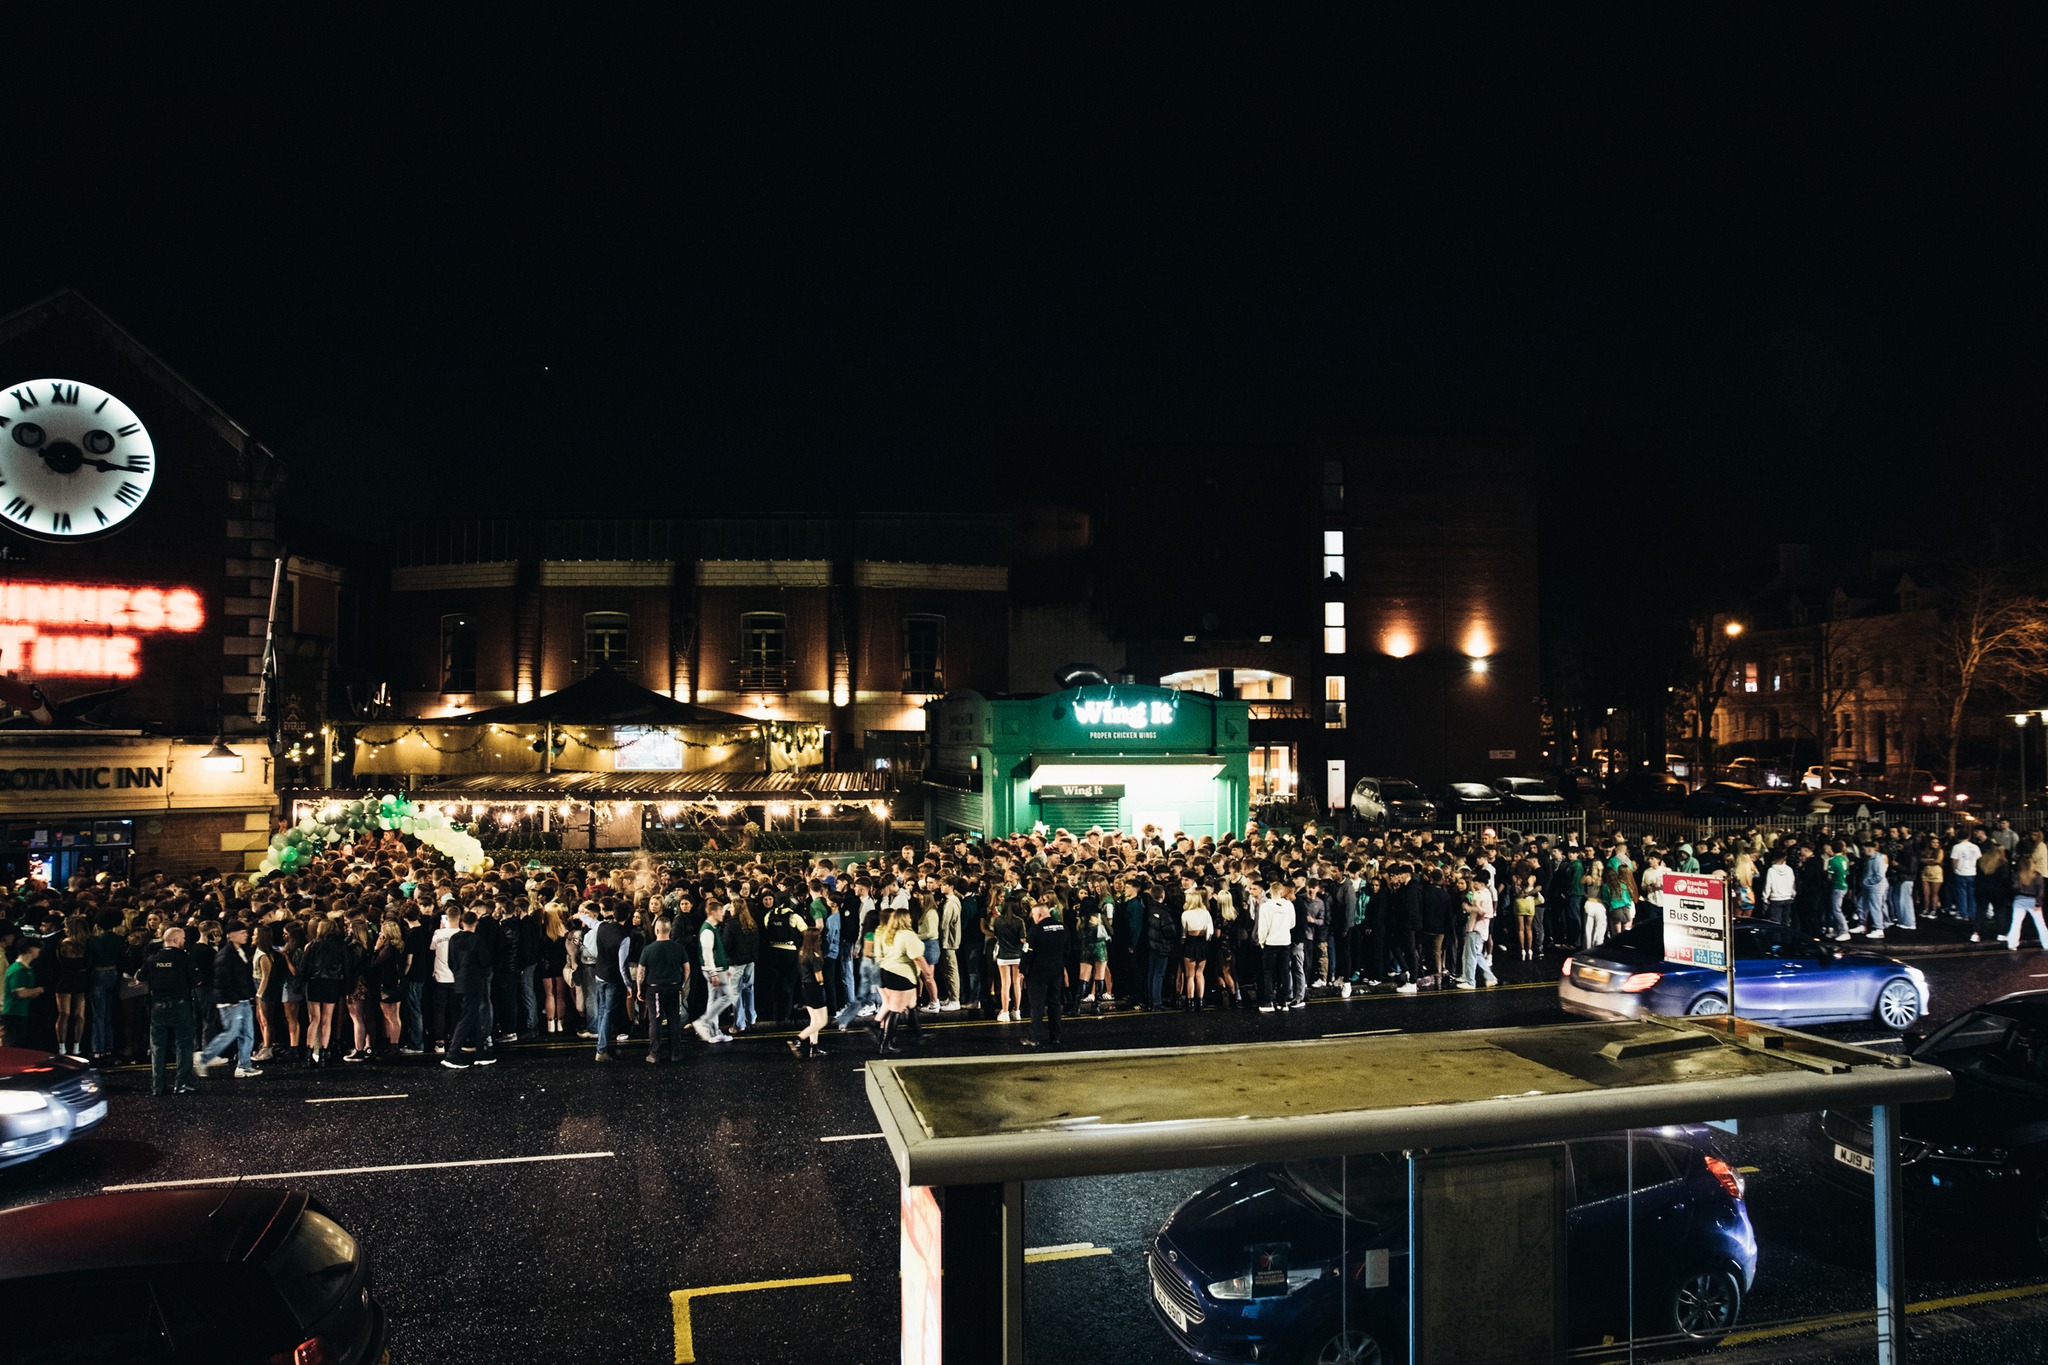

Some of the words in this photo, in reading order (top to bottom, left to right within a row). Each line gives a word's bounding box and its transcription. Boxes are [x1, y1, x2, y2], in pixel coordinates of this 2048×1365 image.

[0, 584, 203, 632] INNESS
[1072, 701, 1148, 729] Wing
[1150, 701, 1173, 724] It
[115, 767, 163, 788] INN
[1062, 786, 1093, 797] Wing
[1094, 786, 1103, 795] It
[1687, 885, 1709, 896] Metro
[1669, 909, 1689, 921] Bus
[1692, 912, 1715, 926] Stop
[1689, 927, 1719, 940] Buildings
[1680, 948, 1691, 958] 93
